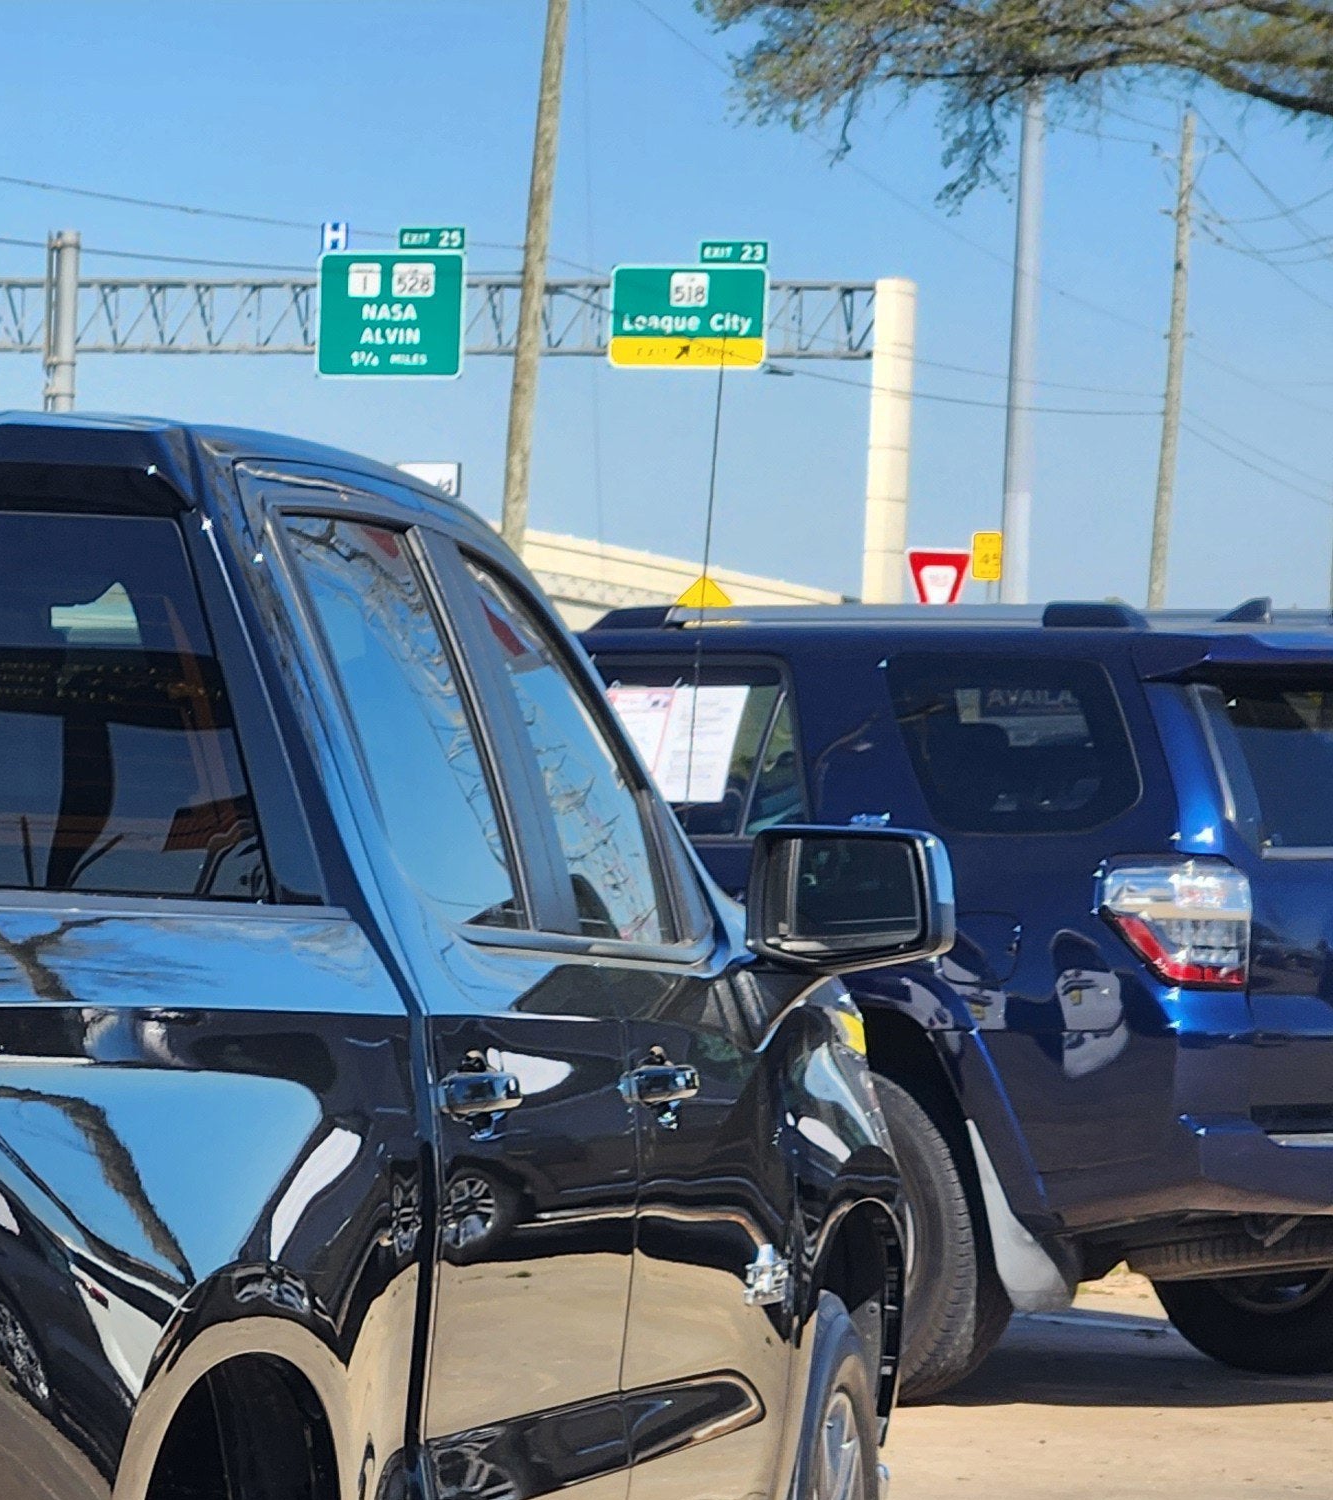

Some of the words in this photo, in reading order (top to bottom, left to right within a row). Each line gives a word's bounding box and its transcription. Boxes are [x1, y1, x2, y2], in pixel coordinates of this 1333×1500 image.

[402, 232, 431, 245] EXIT
[438, 230, 462, 247] 25
[703, 246, 733, 259] EXIT
[740, 244, 764, 261] 23
[396, 274, 432, 293] 528
[674, 285, 705, 303] 518
[361, 303, 417, 321] NASA
[709, 312, 752, 336] City
[359, 327, 421, 344] ALVIN
[389, 353, 428, 366] MILES
